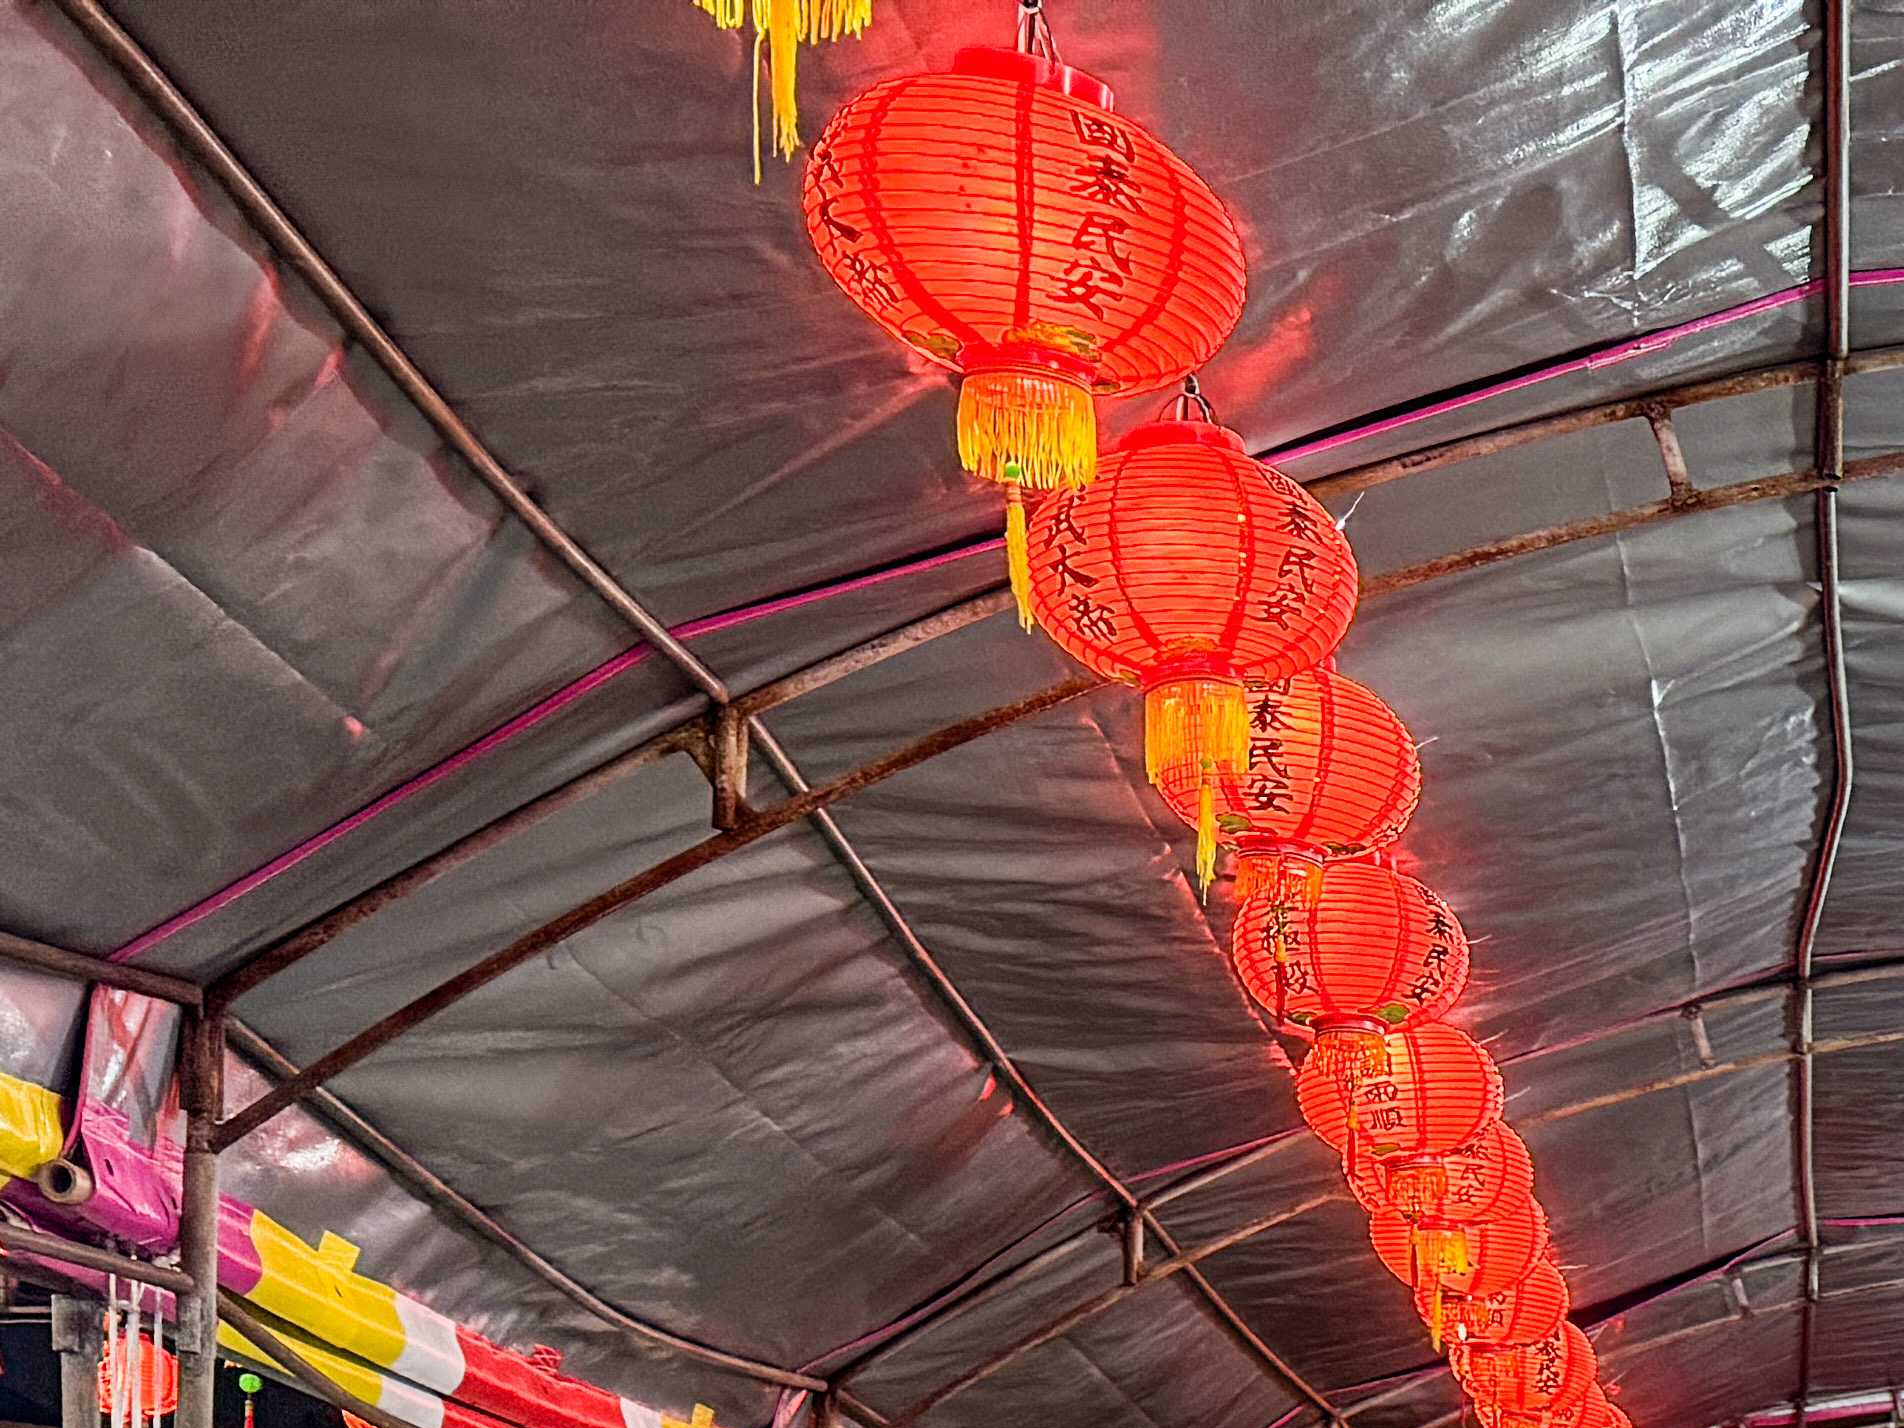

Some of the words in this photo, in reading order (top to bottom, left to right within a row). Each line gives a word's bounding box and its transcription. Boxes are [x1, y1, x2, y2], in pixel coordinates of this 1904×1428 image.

[1046, 109, 1150, 321] 國泰民安
[1254, 464, 1328, 632] 國泰民安
